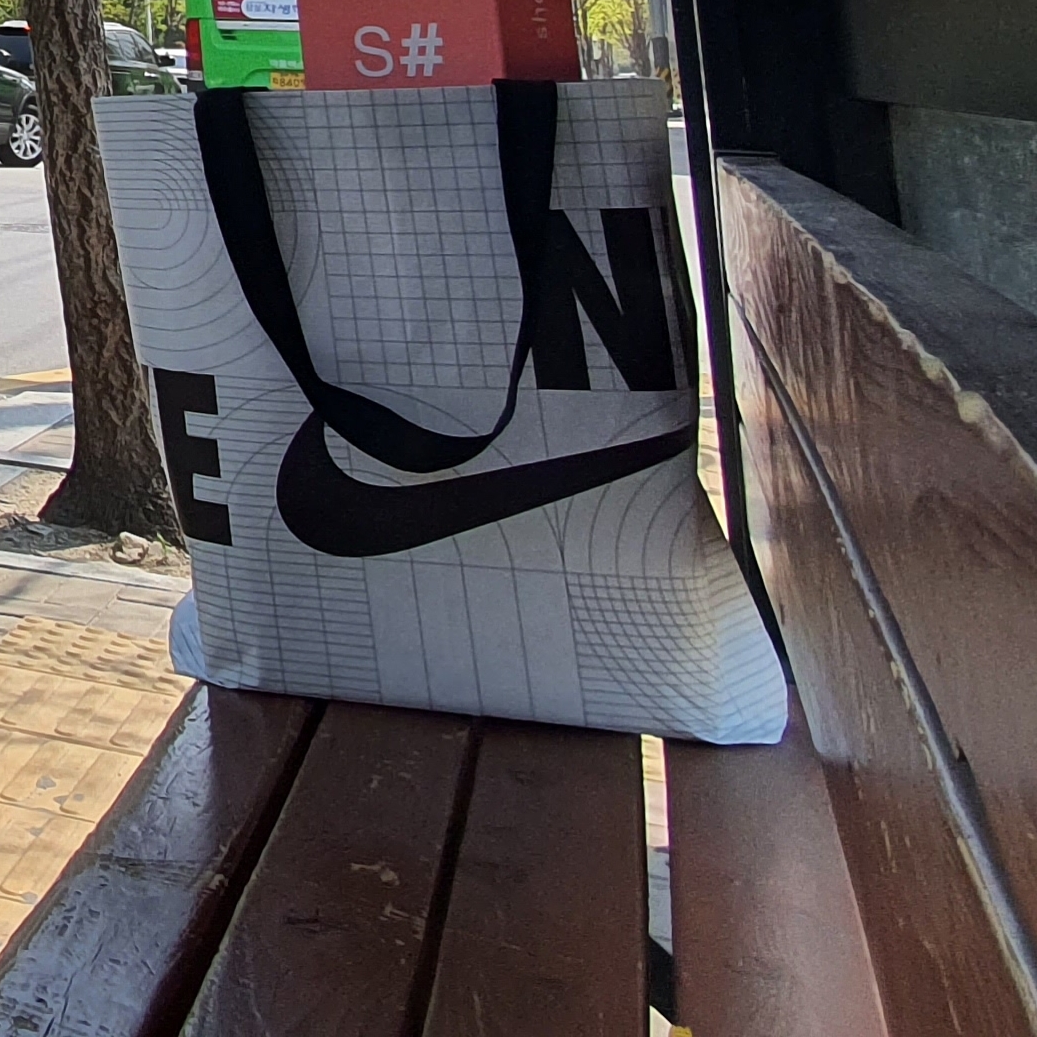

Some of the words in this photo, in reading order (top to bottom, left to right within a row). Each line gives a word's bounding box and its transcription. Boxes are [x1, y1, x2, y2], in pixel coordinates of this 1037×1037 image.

[353, 22, 444, 78] S#
[531, 207, 679, 391] N
[153, 368, 233, 546] E
